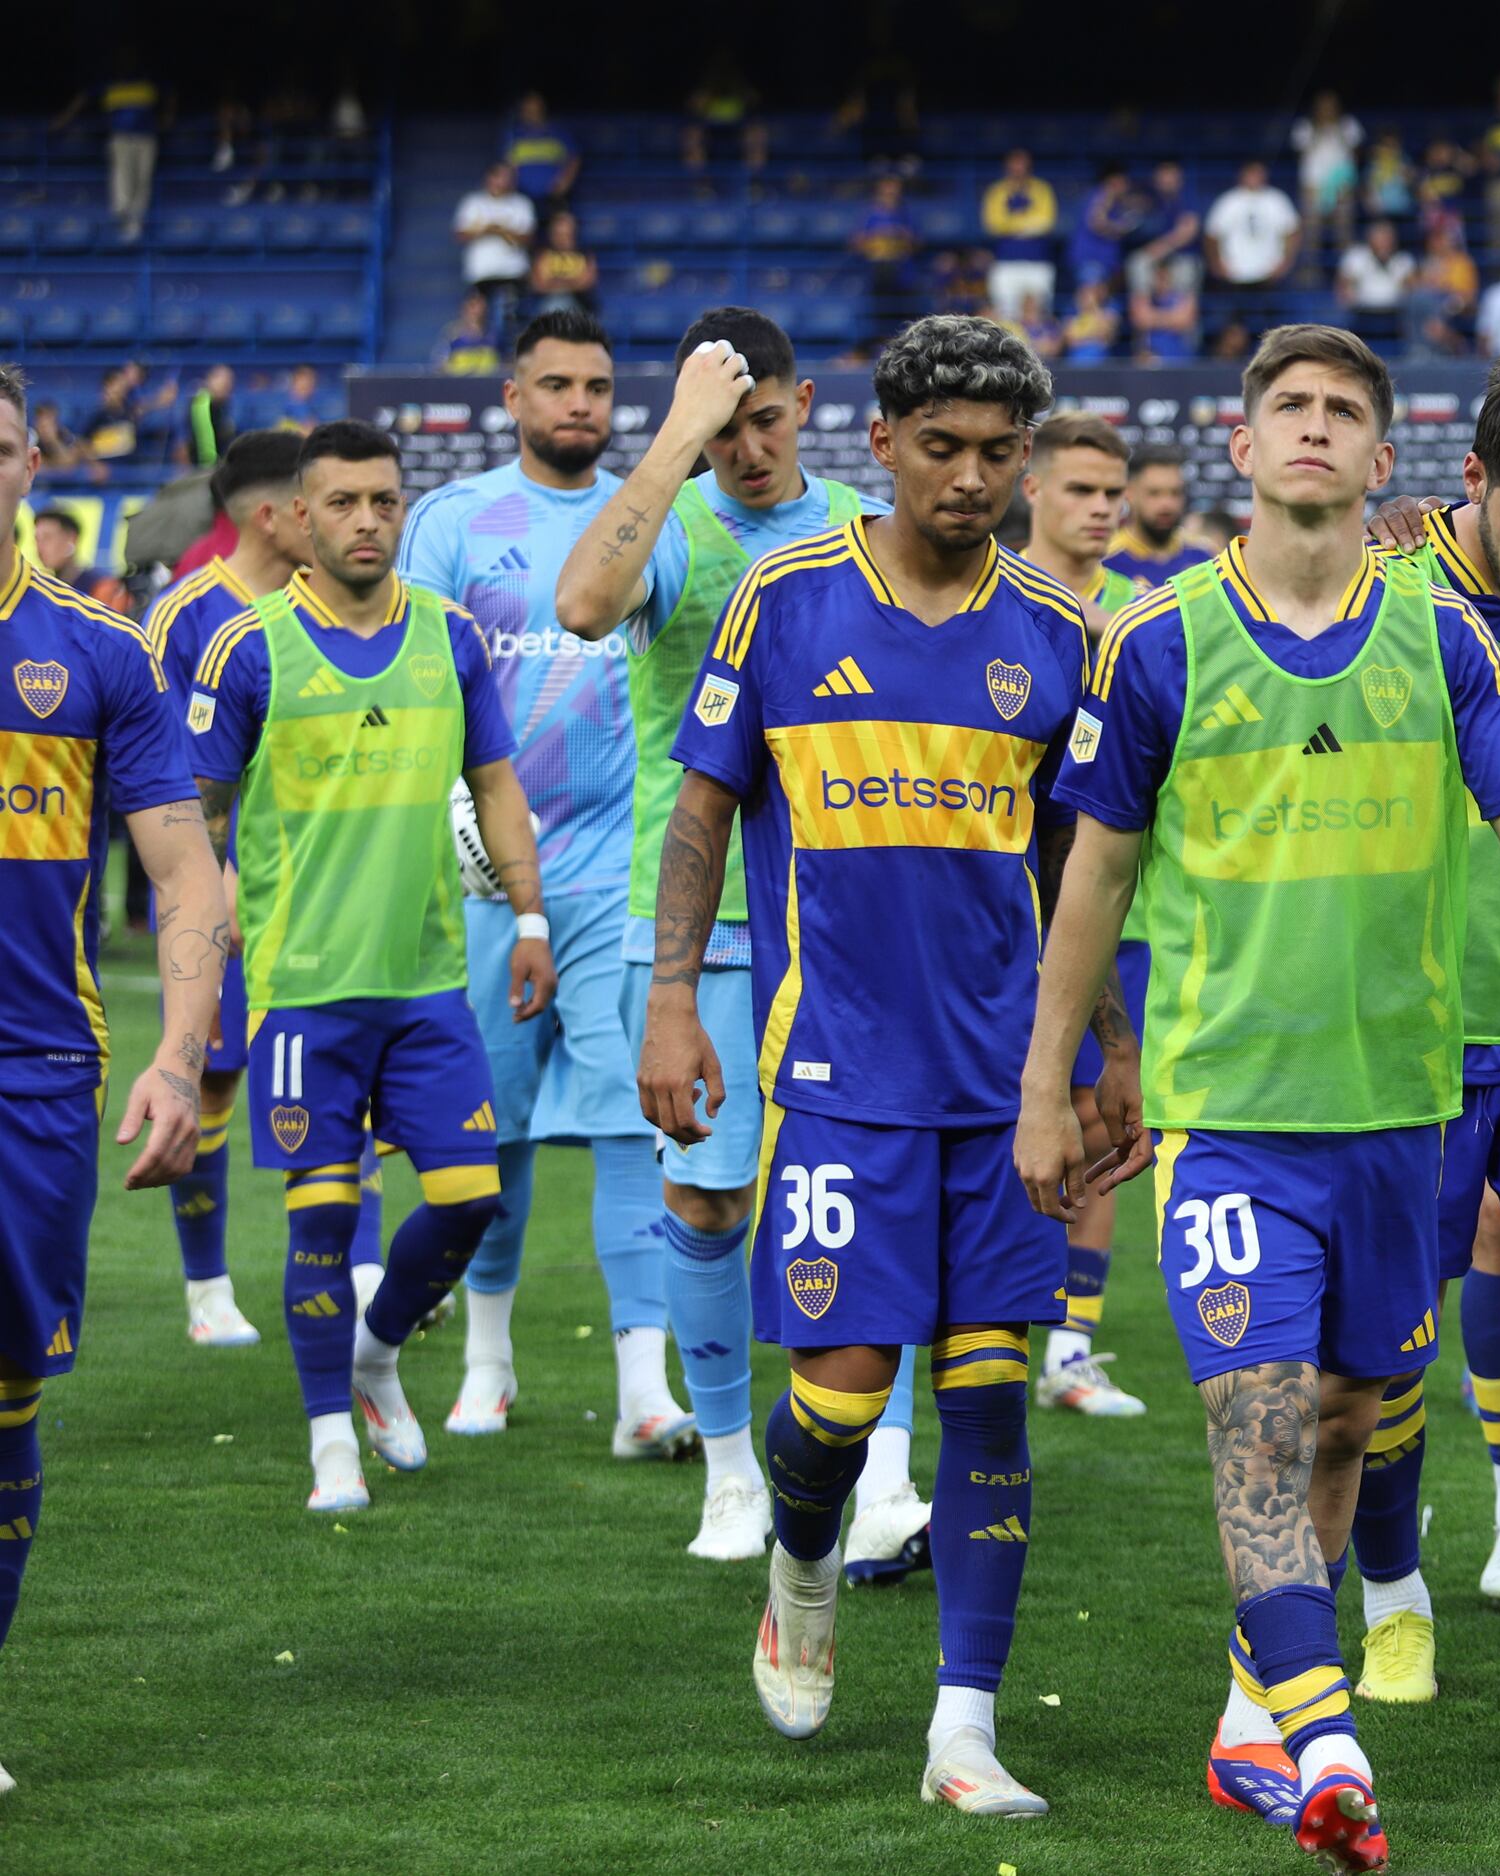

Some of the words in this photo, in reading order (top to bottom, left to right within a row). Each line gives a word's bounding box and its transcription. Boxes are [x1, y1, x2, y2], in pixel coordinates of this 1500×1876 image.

[494, 626, 628, 657] betsso
[22, 678, 61, 691] CABJ
[992, 677, 1025, 697] CABJ
[1367, 684, 1407, 700] CABJ
[821, 767, 1017, 817] betsson
[1211, 792, 1415, 841] betsson
[271, 1031, 304, 1099] 11
[276, 1120, 304, 1131] CABJ
[780, 1163, 856, 1250] 36
[1173, 1192, 1261, 1289] 30
[294, 1250, 344, 1266] CABJ
[794, 1277, 832, 1291] CABJ
[1206, 1300, 1245, 1322] CABJ
[969, 1468, 1032, 1487] CABJ
